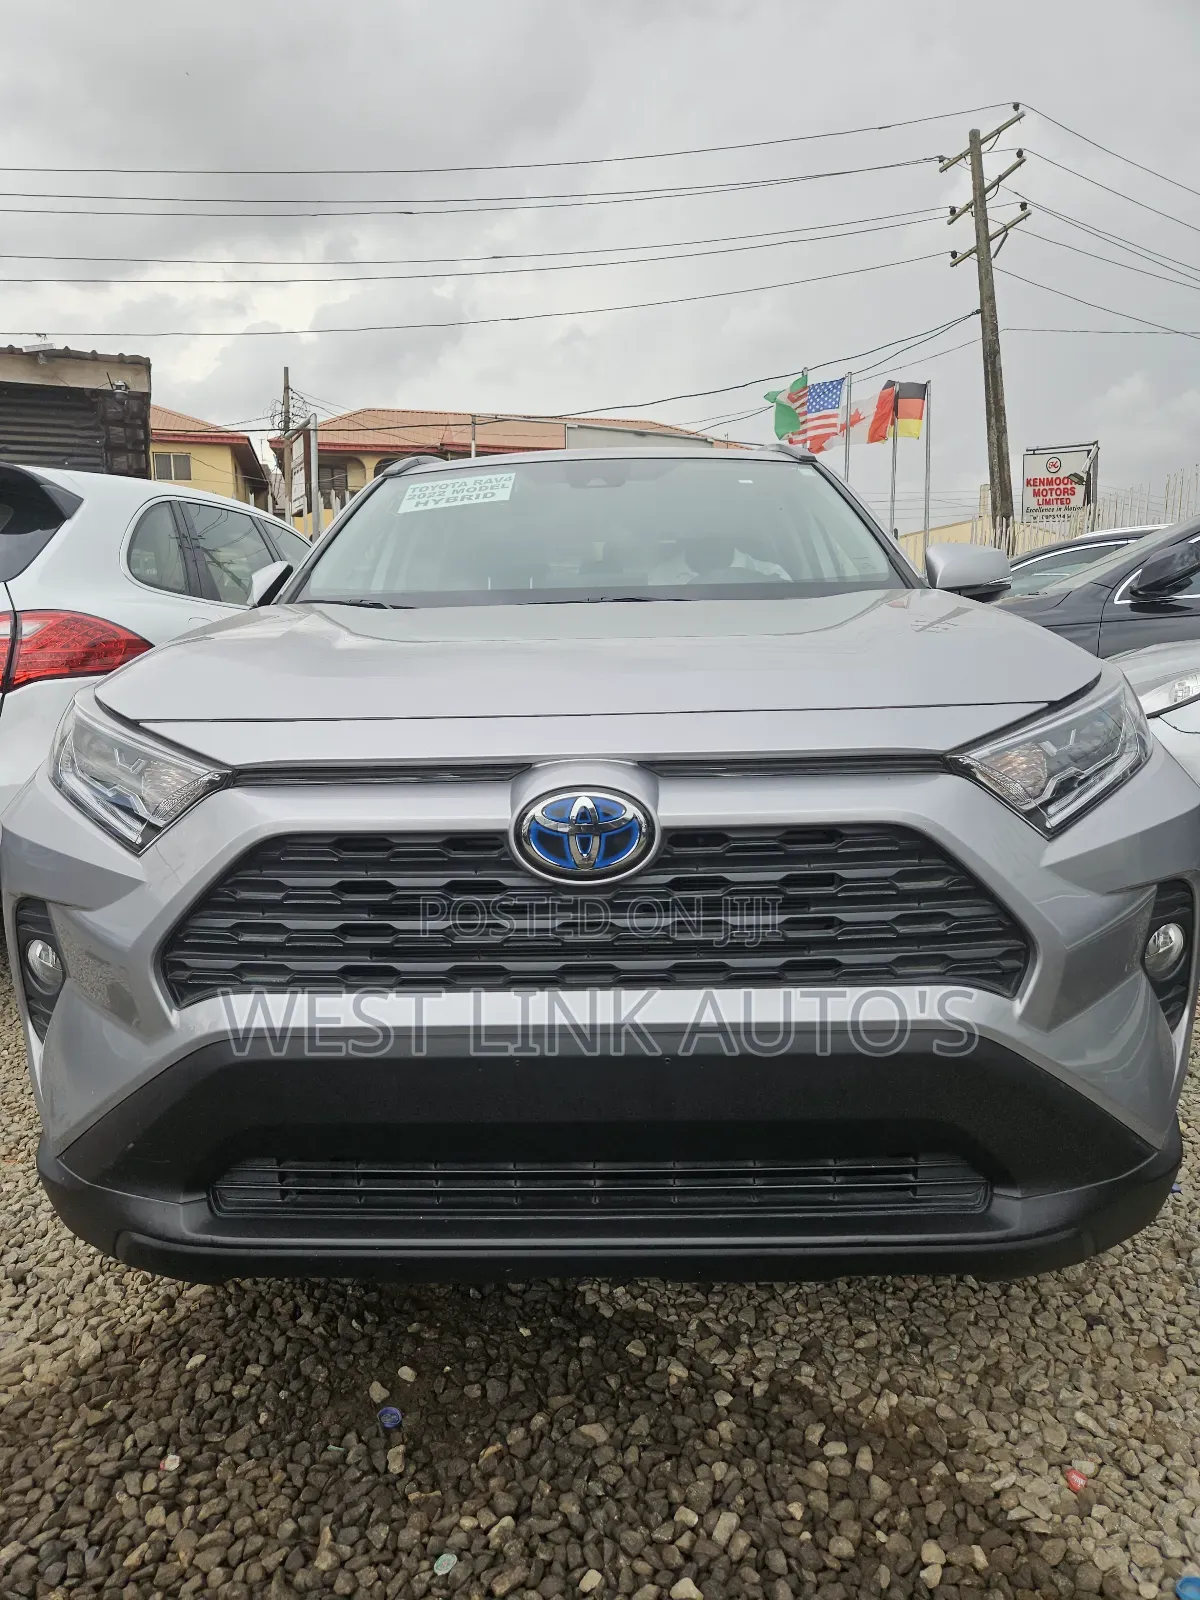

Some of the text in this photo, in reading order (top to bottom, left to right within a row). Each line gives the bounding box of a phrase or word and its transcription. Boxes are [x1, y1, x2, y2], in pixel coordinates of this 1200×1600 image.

[410, 476, 512, 493] TOYOTA RAV4
[1026, 476, 1077, 487] KENMOO
[406, 482, 510, 501] 2022 MODEL
[1032, 487, 1076, 497] MOTORS
[413, 491, 497, 508] HYBRID
[1037, 498, 1071, 506] LIMITED
